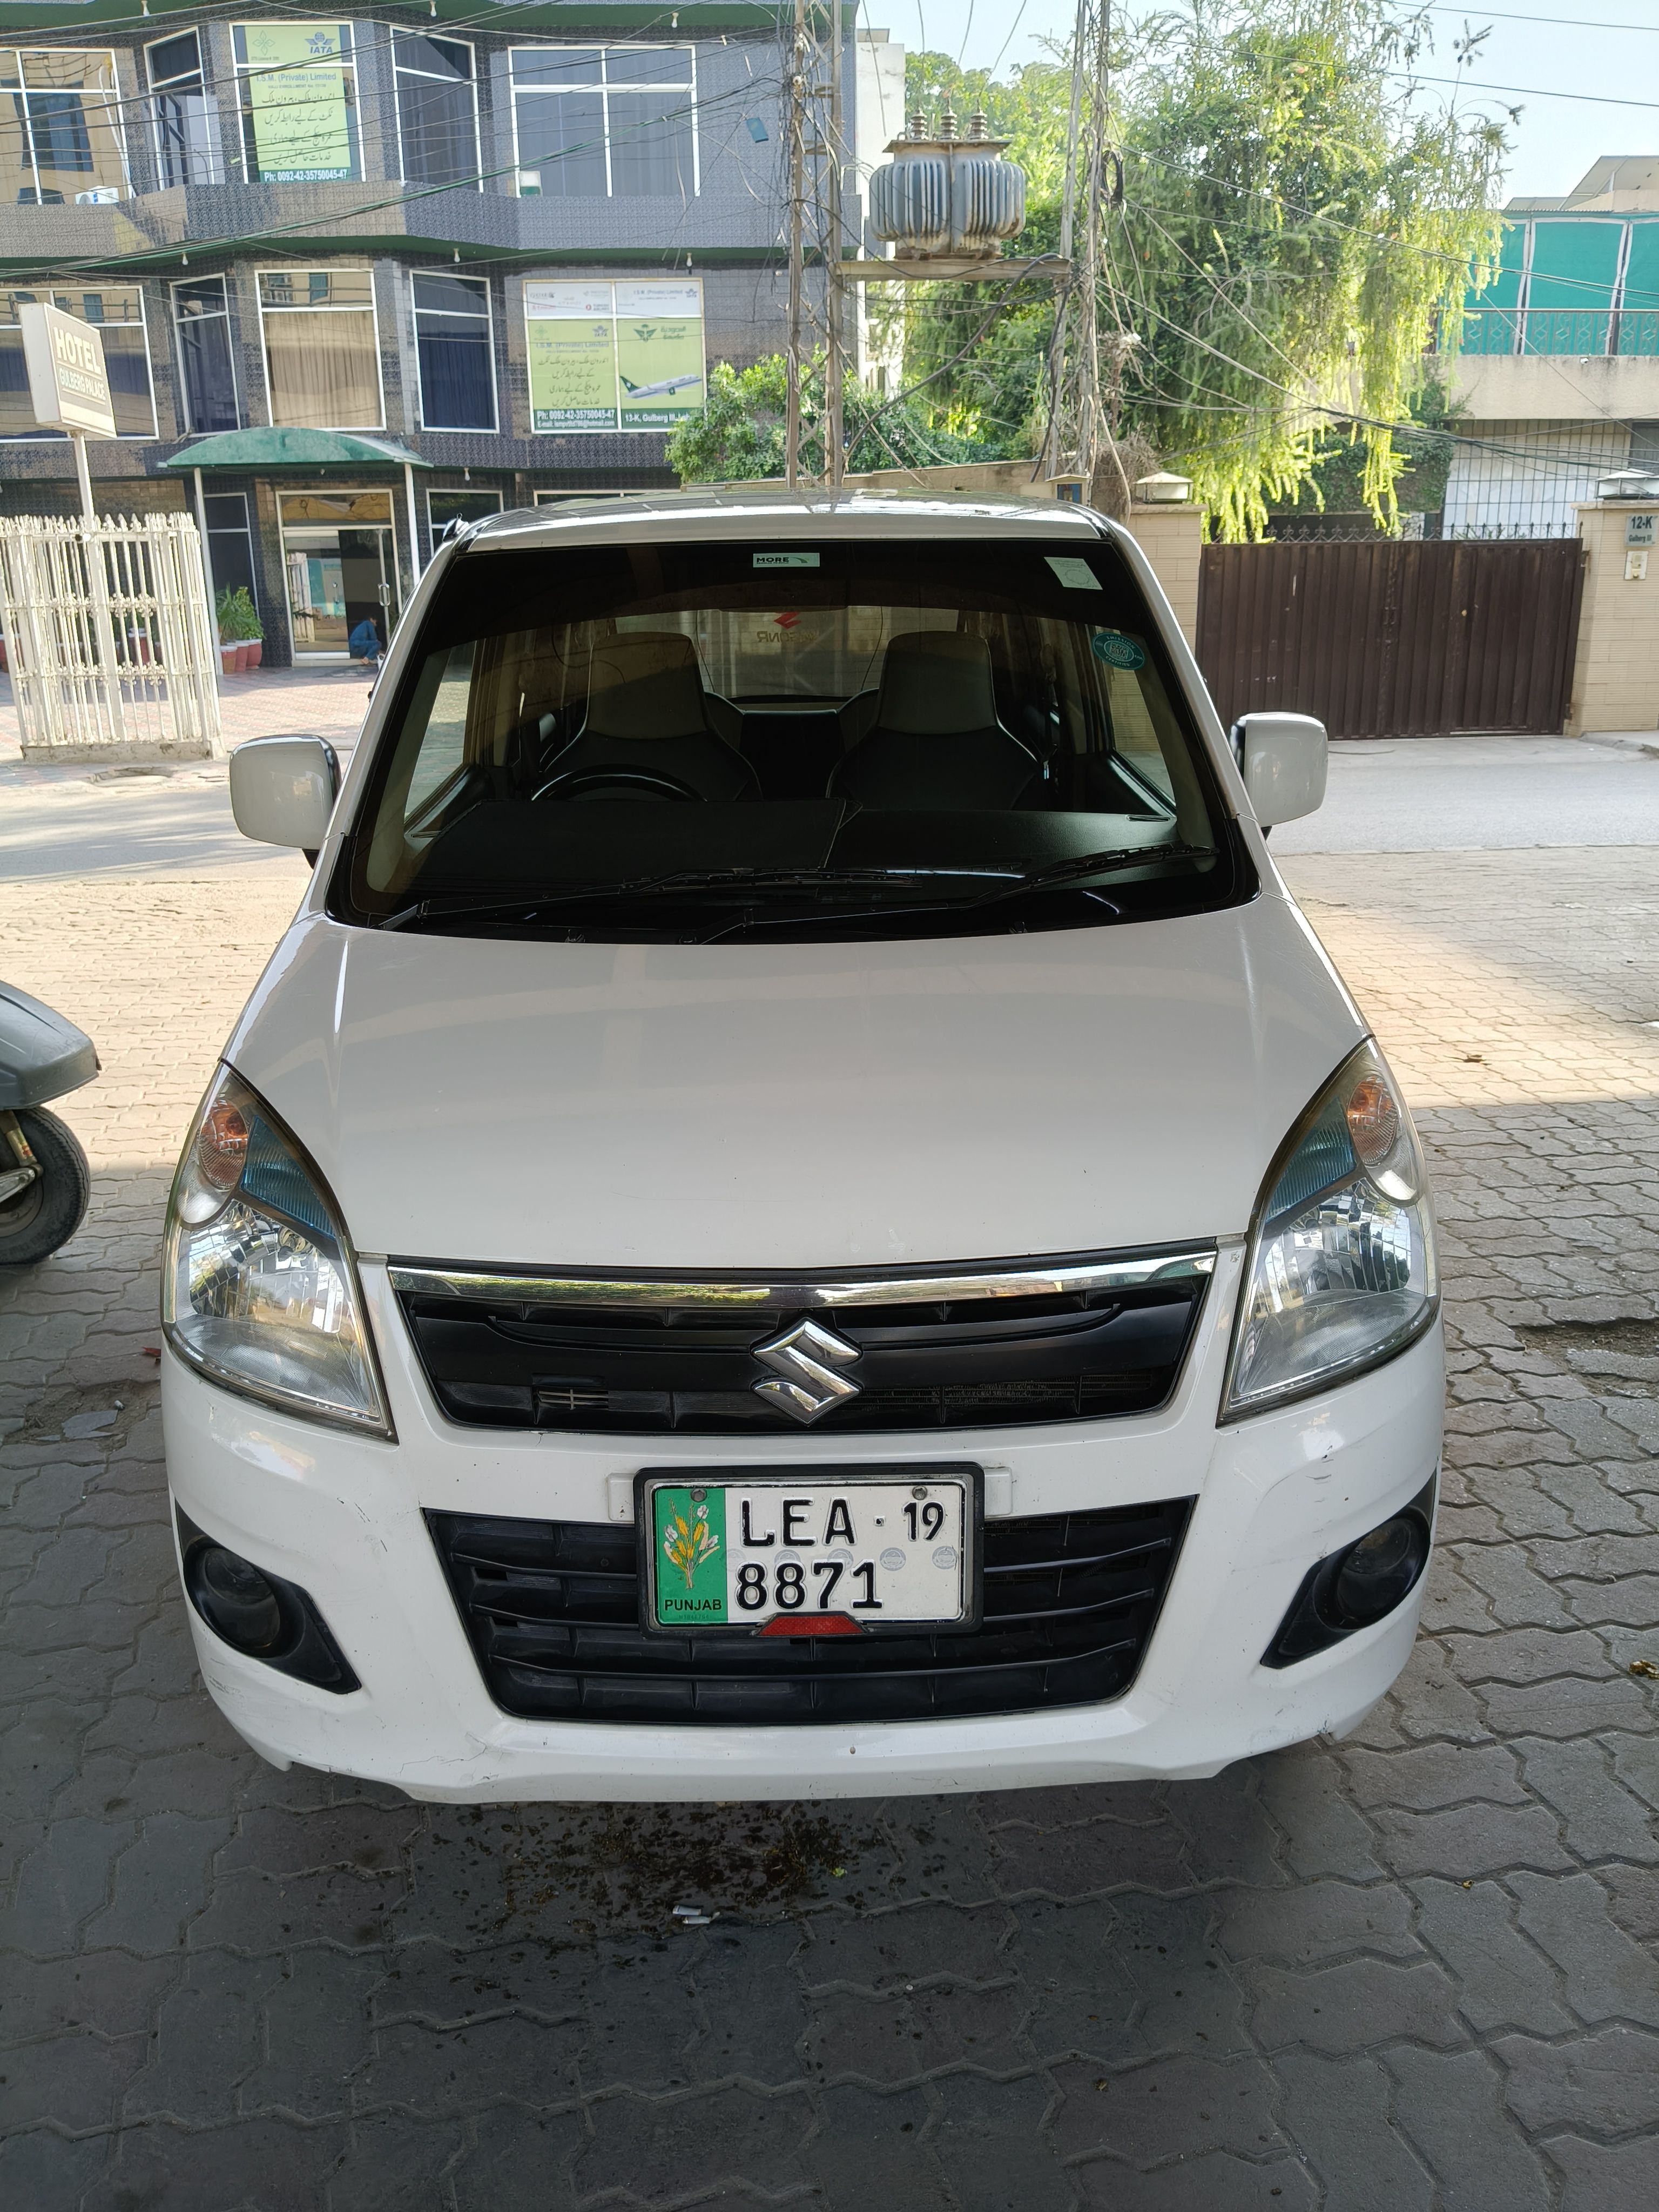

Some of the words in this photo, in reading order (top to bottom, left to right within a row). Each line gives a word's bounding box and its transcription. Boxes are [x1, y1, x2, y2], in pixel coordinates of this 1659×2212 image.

[278, 73, 308, 82] (Private)
[264, 172, 276, 183] Ph:
[277, 169, 347, 182] 0092-42-35750045-47
[54, 326, 102, 375] HOTEL
[59, 368, 86, 393] GULBERG
[85, 376, 106, 401] PALACE
[537, 411, 548, 420] Ph:
[642, 413, 668, 423] Gulberg
[1628, 534, 1645, 543] Gulberg
[1107, 636, 1136, 649] EMISSION
[740, 1497, 857, 1547] LEA
[902, 1501, 947, 1542] 19
[735, 1560, 884, 1610] 8871
[665, 1599, 722, 1610] PUNJAB
